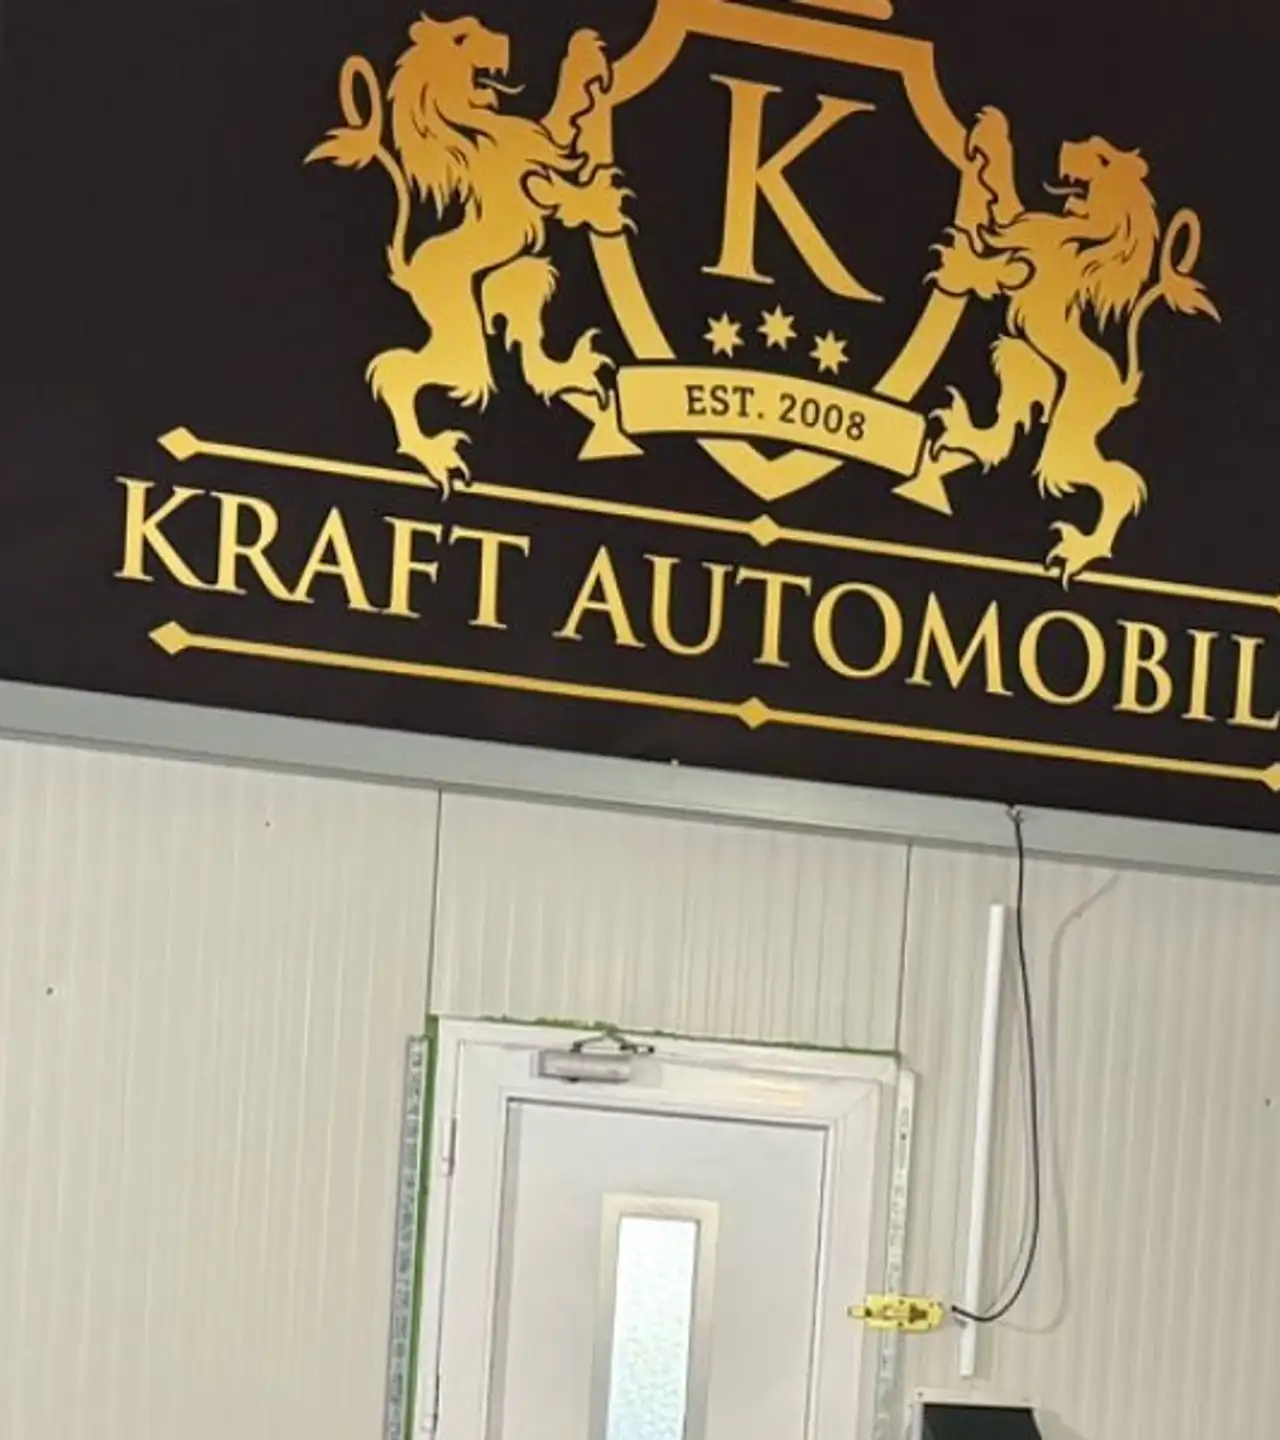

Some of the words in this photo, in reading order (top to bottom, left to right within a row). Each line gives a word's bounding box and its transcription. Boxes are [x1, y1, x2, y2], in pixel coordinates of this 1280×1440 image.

[702, 75, 883, 302] K
[685, 384, 767, 421] EST.
[779, 393, 866, 441] 2008
[114, 477, 531, 630] KRAFT
